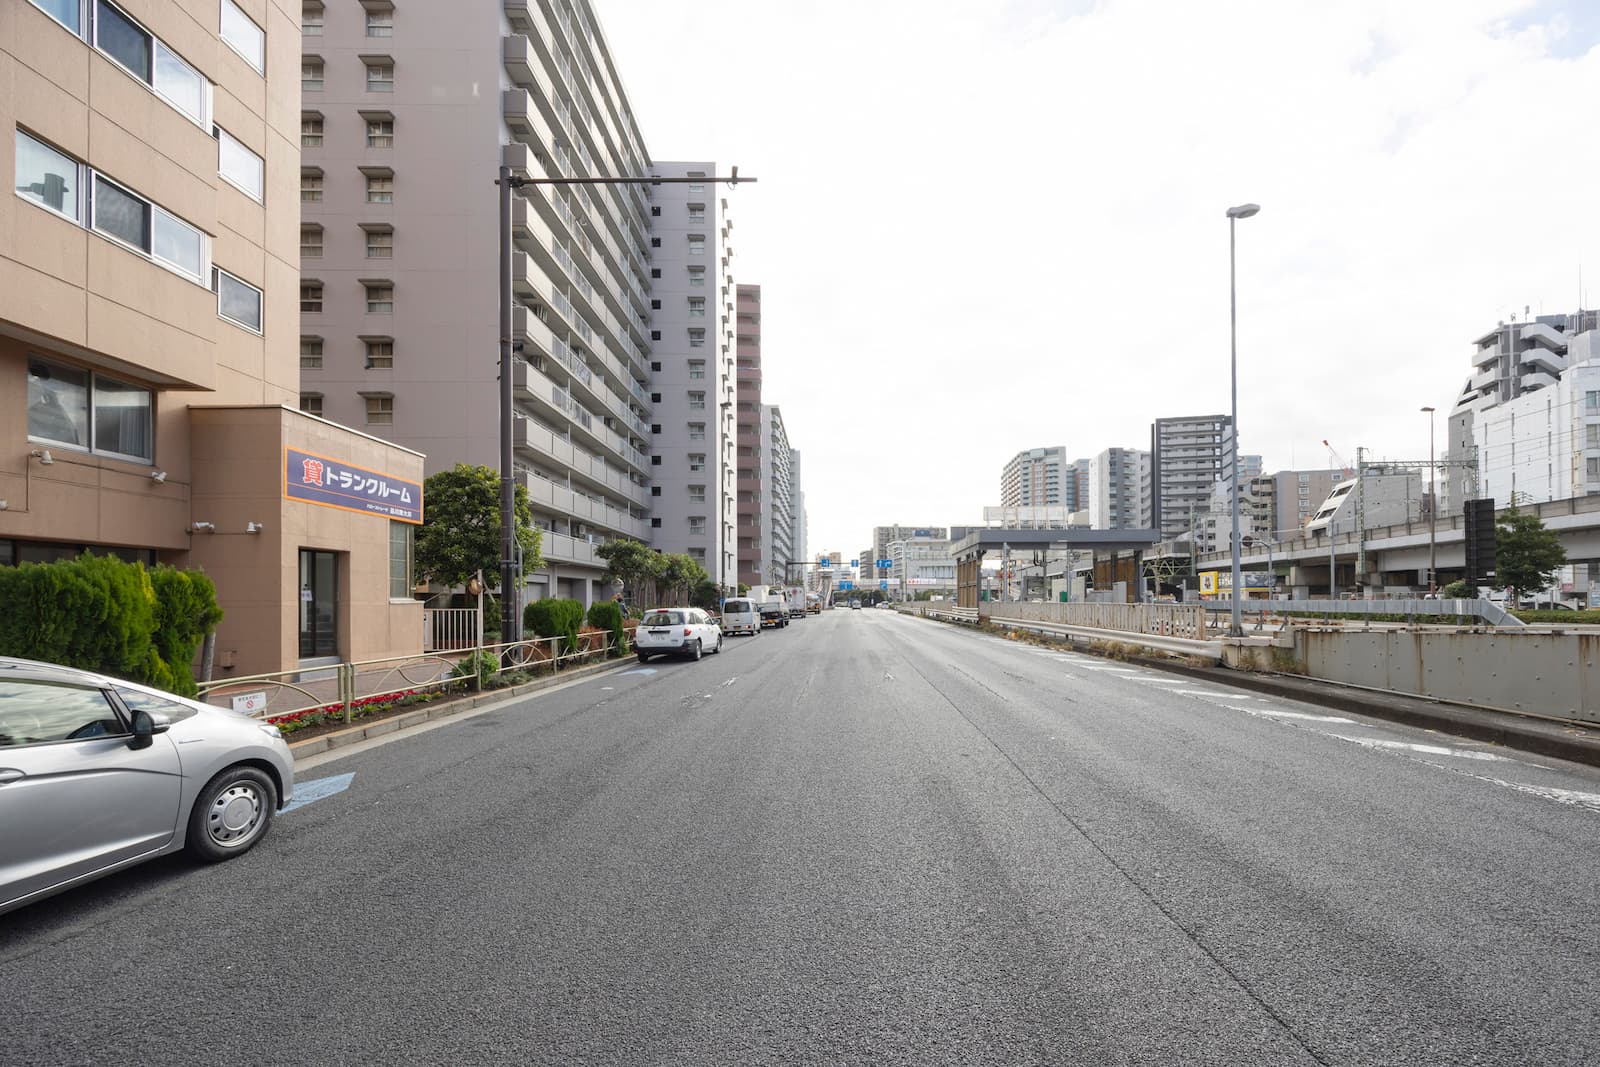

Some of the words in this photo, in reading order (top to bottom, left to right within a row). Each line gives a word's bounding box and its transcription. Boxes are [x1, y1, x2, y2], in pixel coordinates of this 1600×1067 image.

[303, 458, 411, 503] 貸トランクルーム
